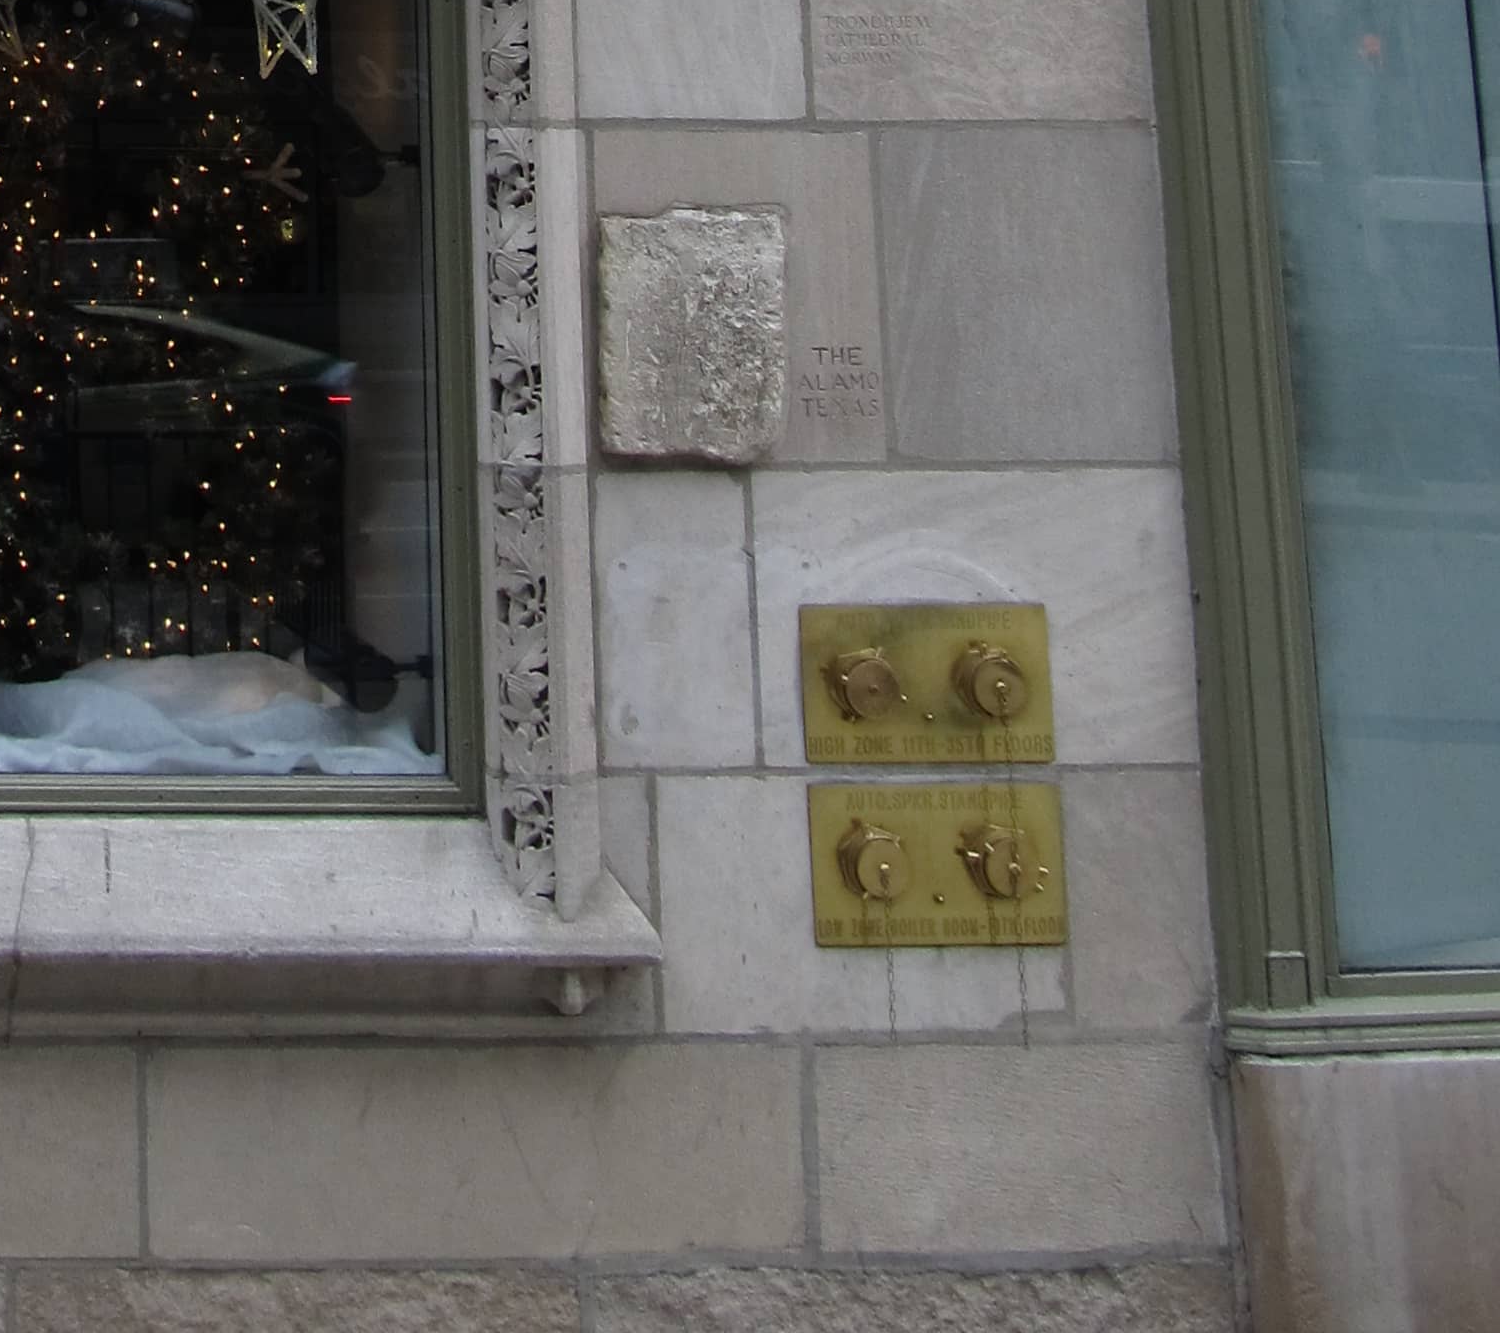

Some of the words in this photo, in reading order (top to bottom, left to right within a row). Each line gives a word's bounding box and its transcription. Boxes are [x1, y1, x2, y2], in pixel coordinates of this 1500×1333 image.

[812, 346, 864, 366] THE
[800, 372, 880, 392] ALAMO
[802, 397, 882, 417] TEXAS
[808, 734, 845, 755] HIGH
[853, 735, 894, 755] ZONE
